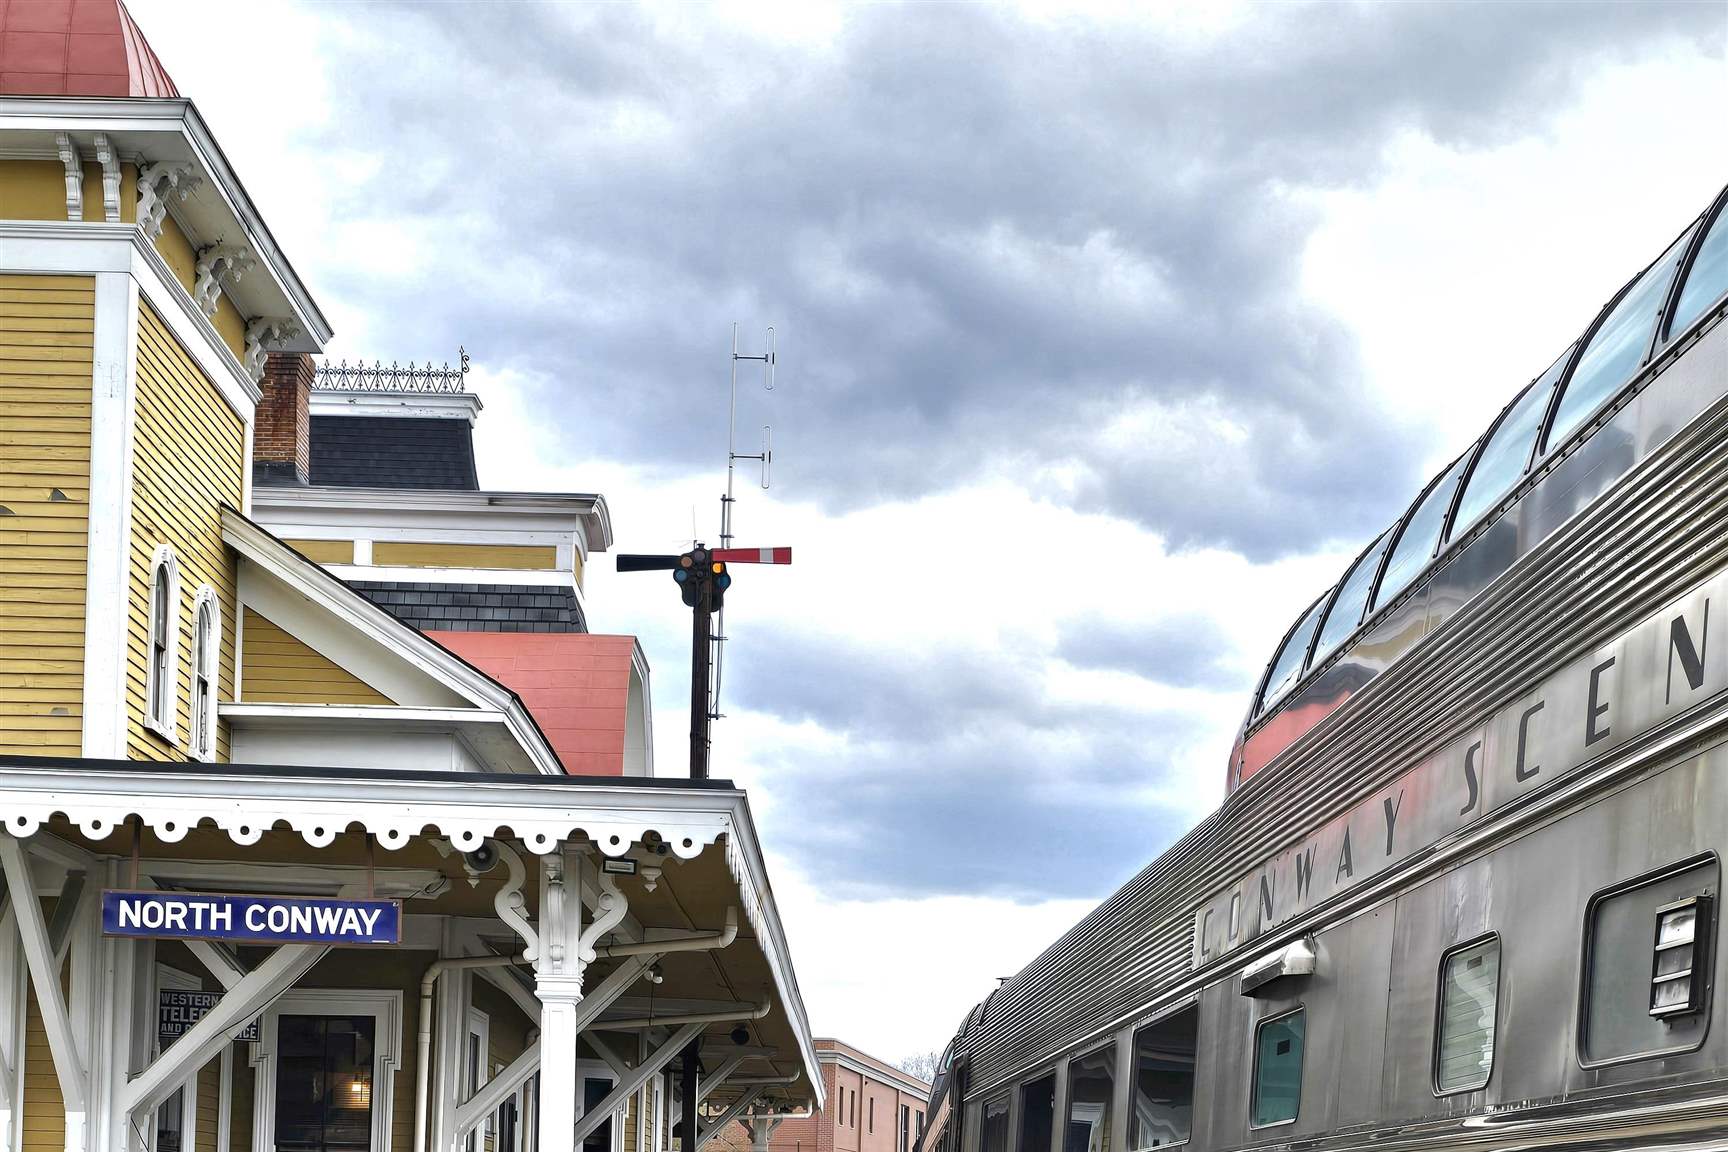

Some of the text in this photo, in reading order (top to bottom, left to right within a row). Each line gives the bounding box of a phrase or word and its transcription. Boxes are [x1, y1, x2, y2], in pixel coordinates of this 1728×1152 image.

[1201, 598, 1710, 957] CONWAY SCEN
[118, 900, 382, 936] NORTH CONWAY
[160, 992, 219, 1007] WESTERN
[160, 1023, 182, 1033] AND
